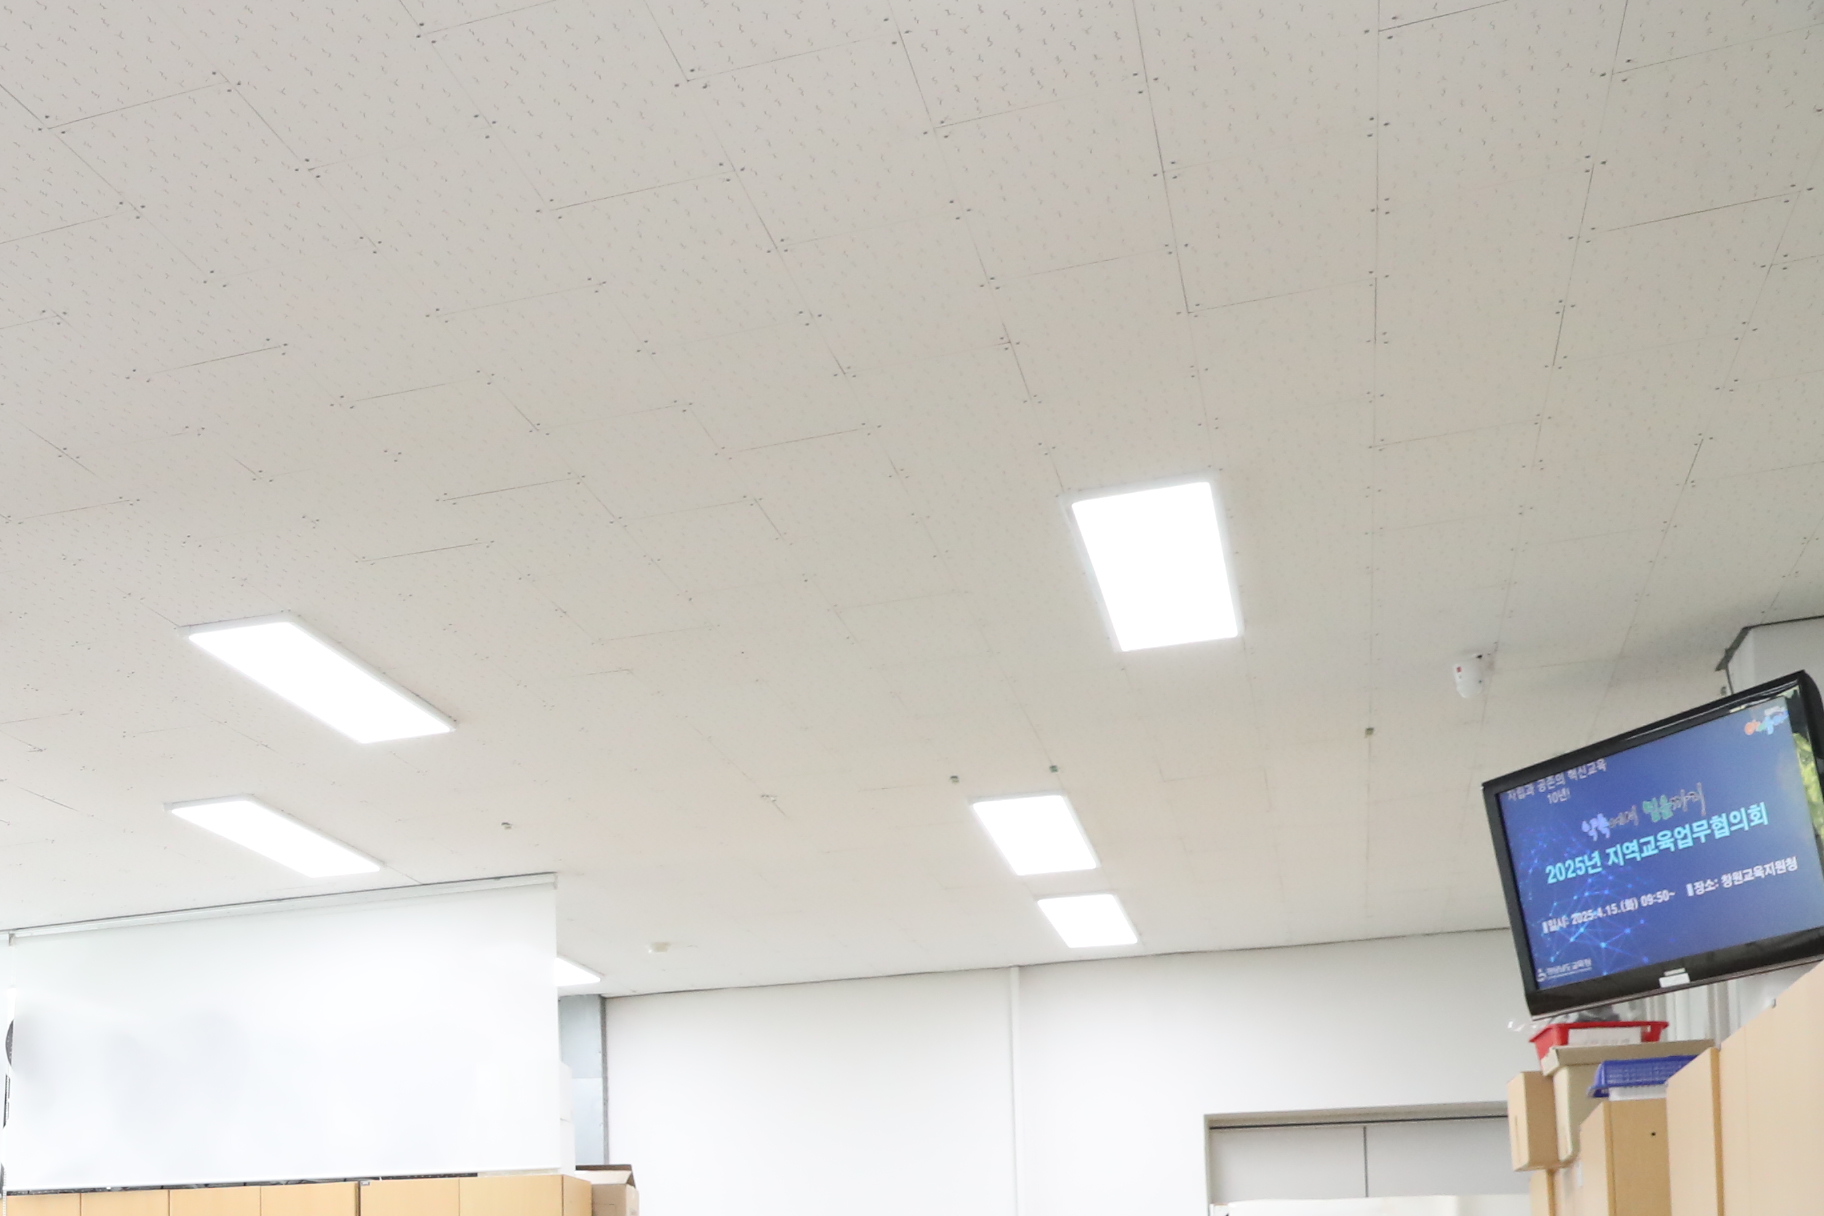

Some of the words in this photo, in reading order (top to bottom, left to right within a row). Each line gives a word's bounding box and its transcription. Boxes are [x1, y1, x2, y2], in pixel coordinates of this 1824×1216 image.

[1545, 853, 1602, 884] 2025년
[1606, 801, 1769, 867] 지역교육업무협의회
[1721, 856, 1798, 888] 창원교육지원청
